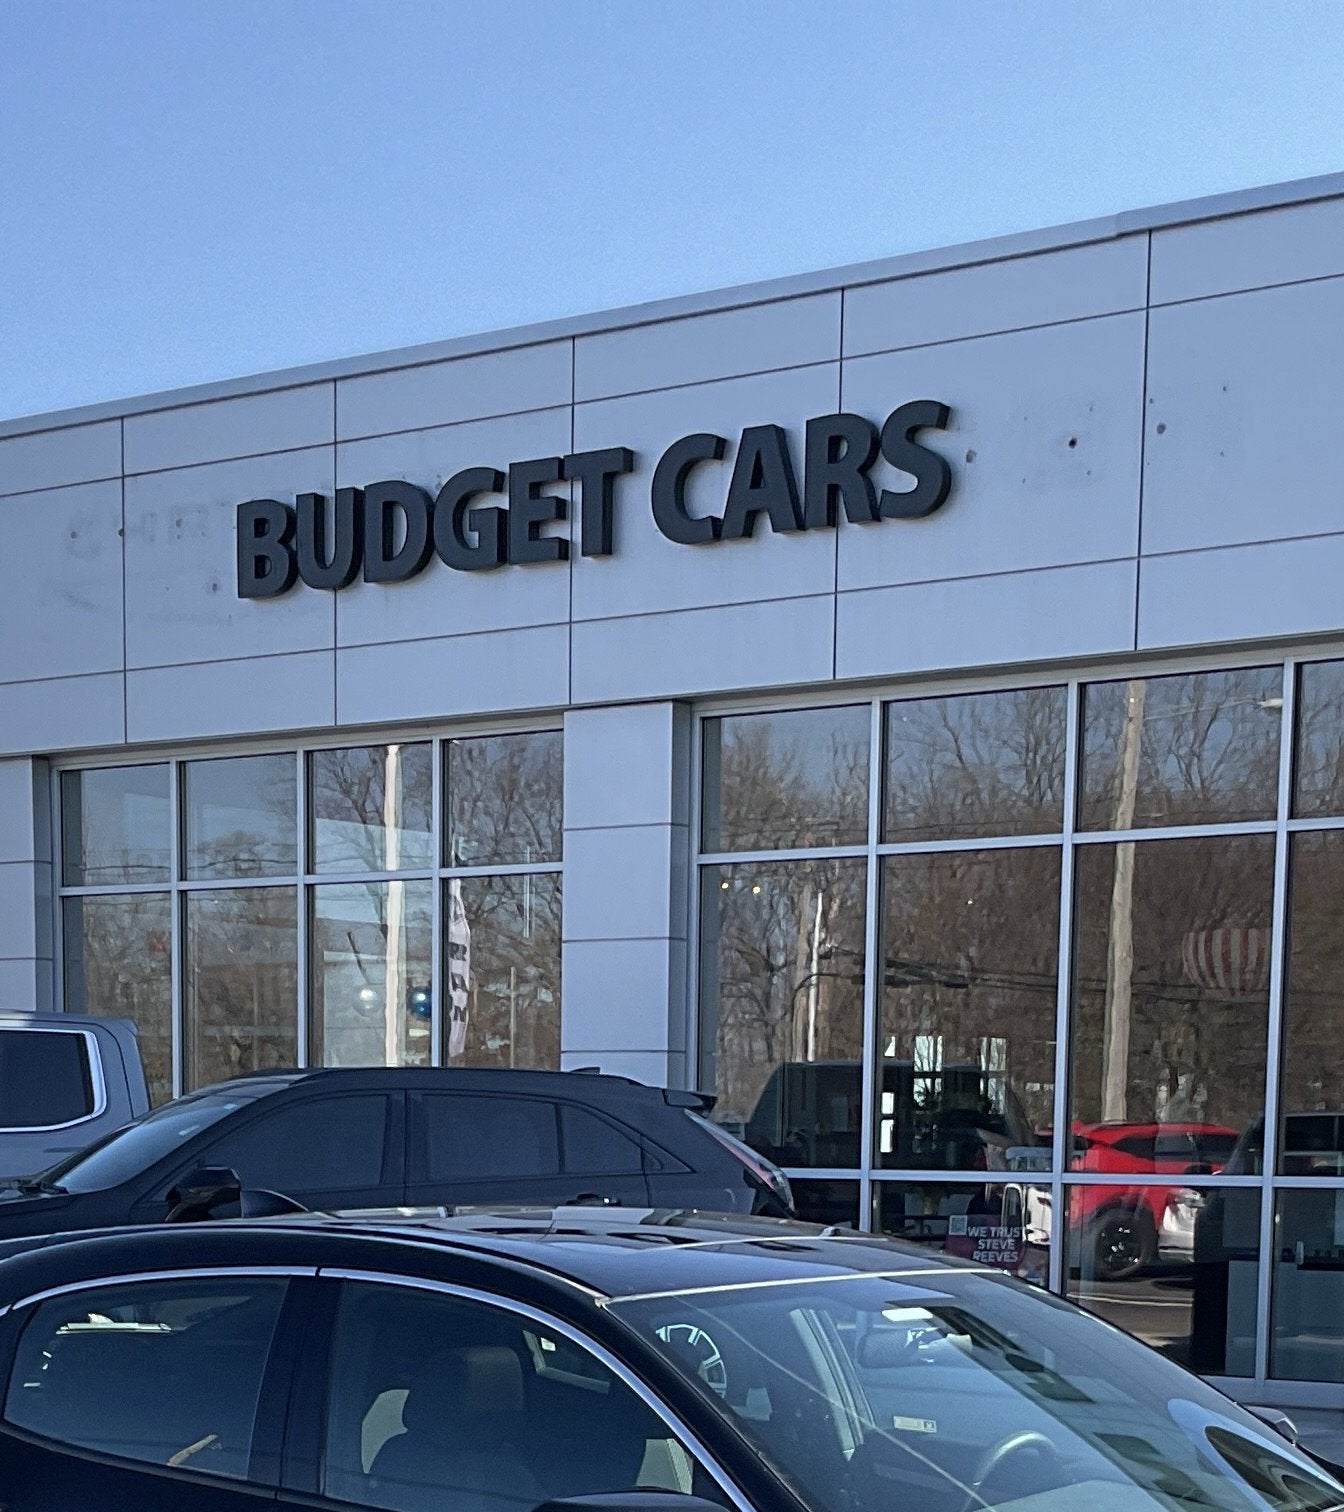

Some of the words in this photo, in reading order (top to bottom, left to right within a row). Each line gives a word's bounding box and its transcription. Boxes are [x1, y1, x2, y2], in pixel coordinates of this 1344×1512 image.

[237, 446, 634, 599] BUDGET
[651, 400, 952, 545] CARS
[968, 1226, 987, 1237] WE
[978, 1238, 1015, 1250] STEVE
[972, 1250, 1018, 1262] REEVES
